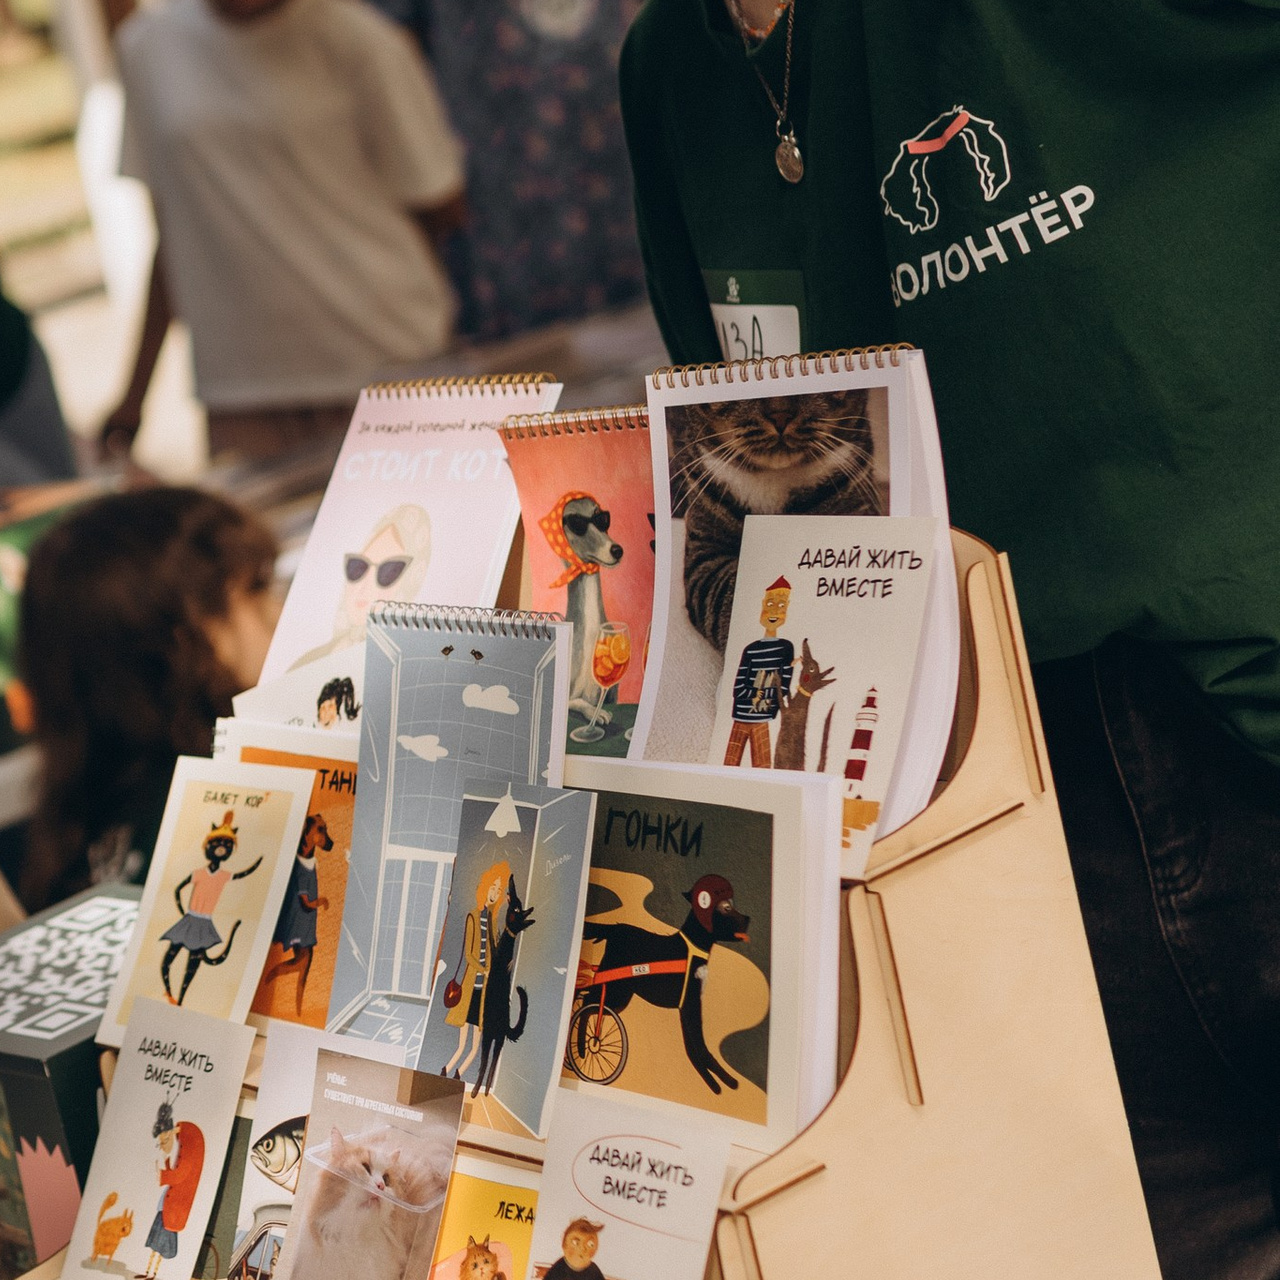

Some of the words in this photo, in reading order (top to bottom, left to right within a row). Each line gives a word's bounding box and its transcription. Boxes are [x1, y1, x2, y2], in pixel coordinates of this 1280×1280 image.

[344, 448, 442, 483] СТОИТ
[449, 447, 508, 481] КОТ
[797, 545, 861, 570] ДАВАЙ
[866, 549, 923, 570] ЖИТЬ
[816, 577, 893, 598] ВМЕСТЕ
[318, 769, 357, 796] ТАН
[203, 790, 238, 806] БАЛЕТ
[604, 807, 704, 857] ГОНКИ
[137, 1036, 177, 1061] ДАВАЙ
[177, 1047, 214, 1073] ЖИТЬ
[144, 1063, 193, 1092] ВМЕСТЕ
[589, 1145, 642, 1174] ДАВАЙ
[645, 1156, 695, 1187] ЖИТЬ
[602, 1175, 668, 1208] ВМЕСТЕ
[494, 1200, 536, 1225] ЛЕЖА
